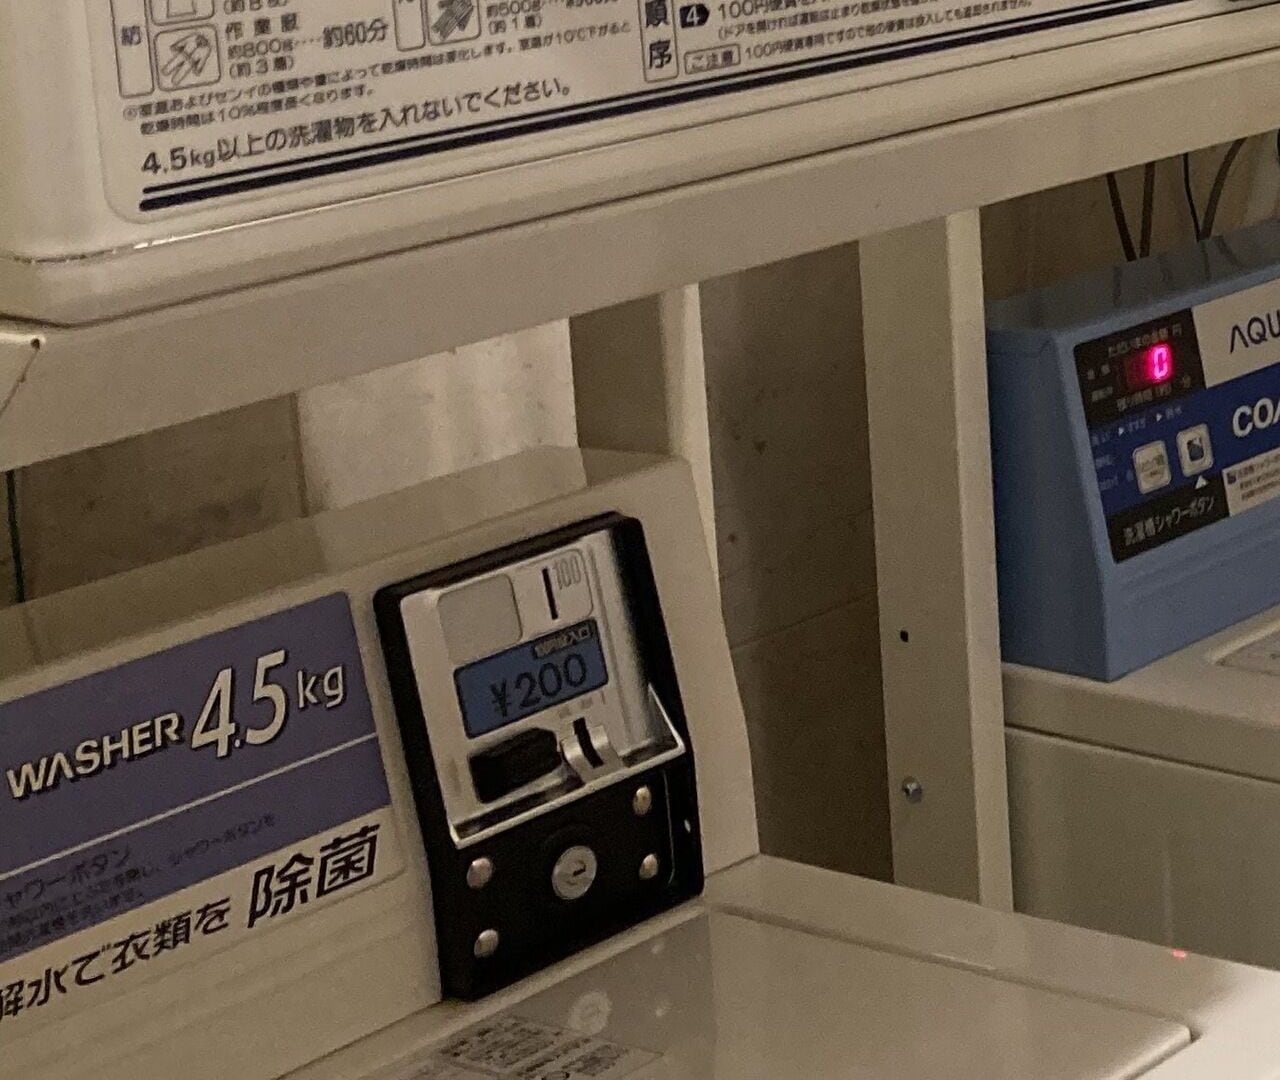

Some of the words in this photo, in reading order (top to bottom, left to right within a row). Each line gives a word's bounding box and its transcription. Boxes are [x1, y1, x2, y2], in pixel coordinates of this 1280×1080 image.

[140, 77, 570, 175] 4.5kg以上の洗濯物を入れないでください。
[1152, 344, 1170, 380] 0
[489, 652, 587, 717] ¥200
[6, 712, 183, 800] WASHER
[248, 823, 381, 929] 除菌
